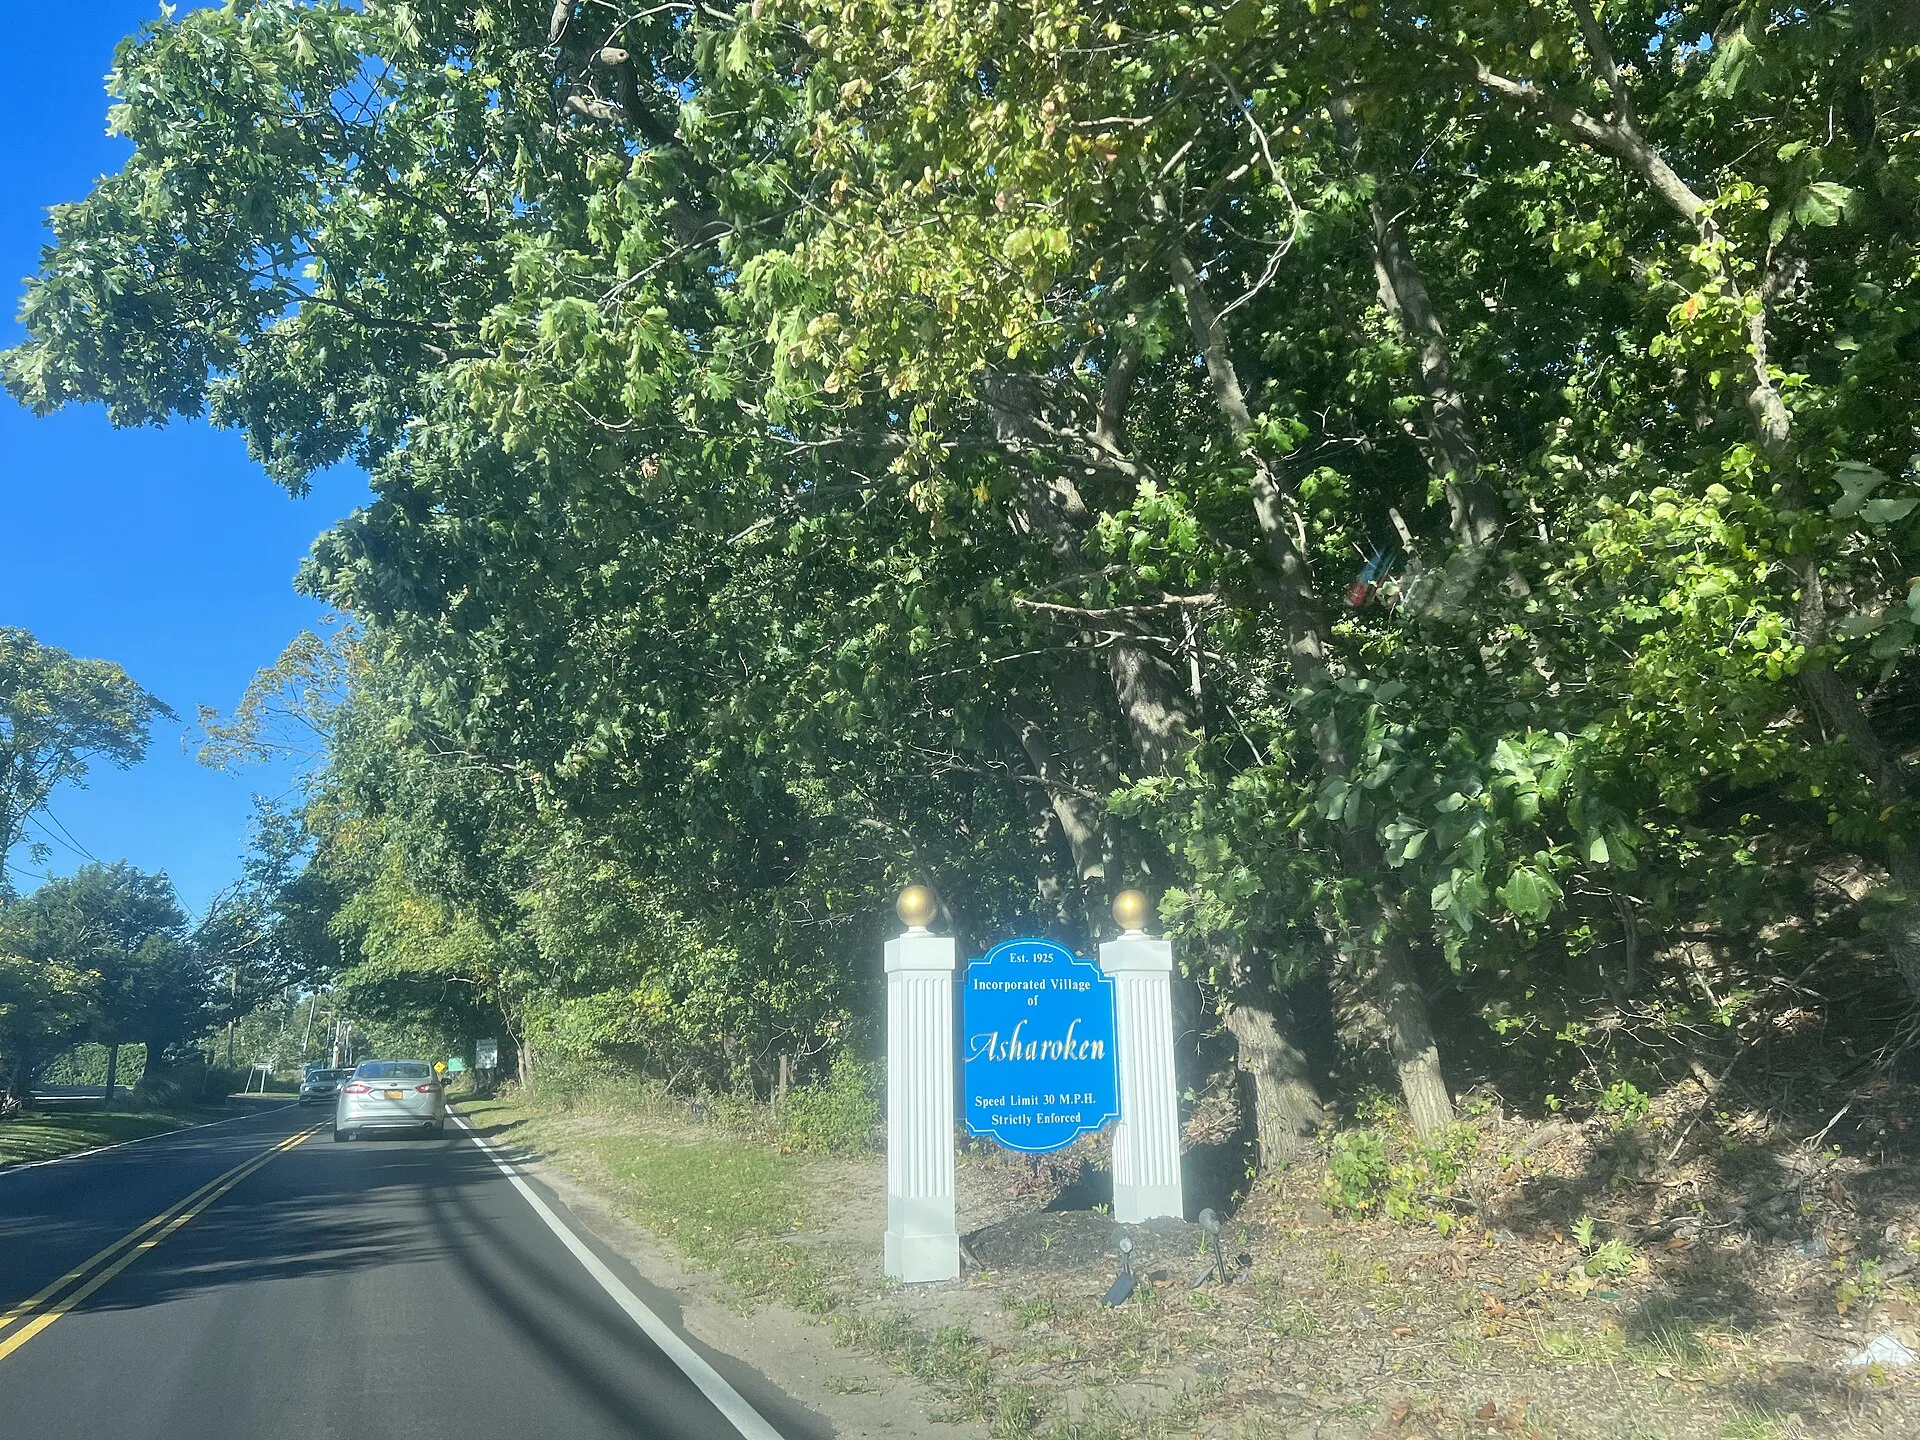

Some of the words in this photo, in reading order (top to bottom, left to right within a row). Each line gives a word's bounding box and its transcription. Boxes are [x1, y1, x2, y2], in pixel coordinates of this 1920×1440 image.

[1009, 953, 1029, 963] Est.
[1033, 953, 1054, 963] 1925
[973, 978, 1046, 993] Incorporated
[1050, 979, 1091, 993] Village
[1027, 995, 1039, 1006] of
[962, 1018, 1106, 1062] Asharoken
[974, 1096, 1006, 1109] Speed
[1010, 1095, 1039, 1106] Limit
[1043, 1095, 1055, 1105] 30
[1059, 1093, 1096, 1105] M.P.H.
[991, 1114, 1032, 1126] Strictly
[1036, 1112, 1081, 1124] Enforced
